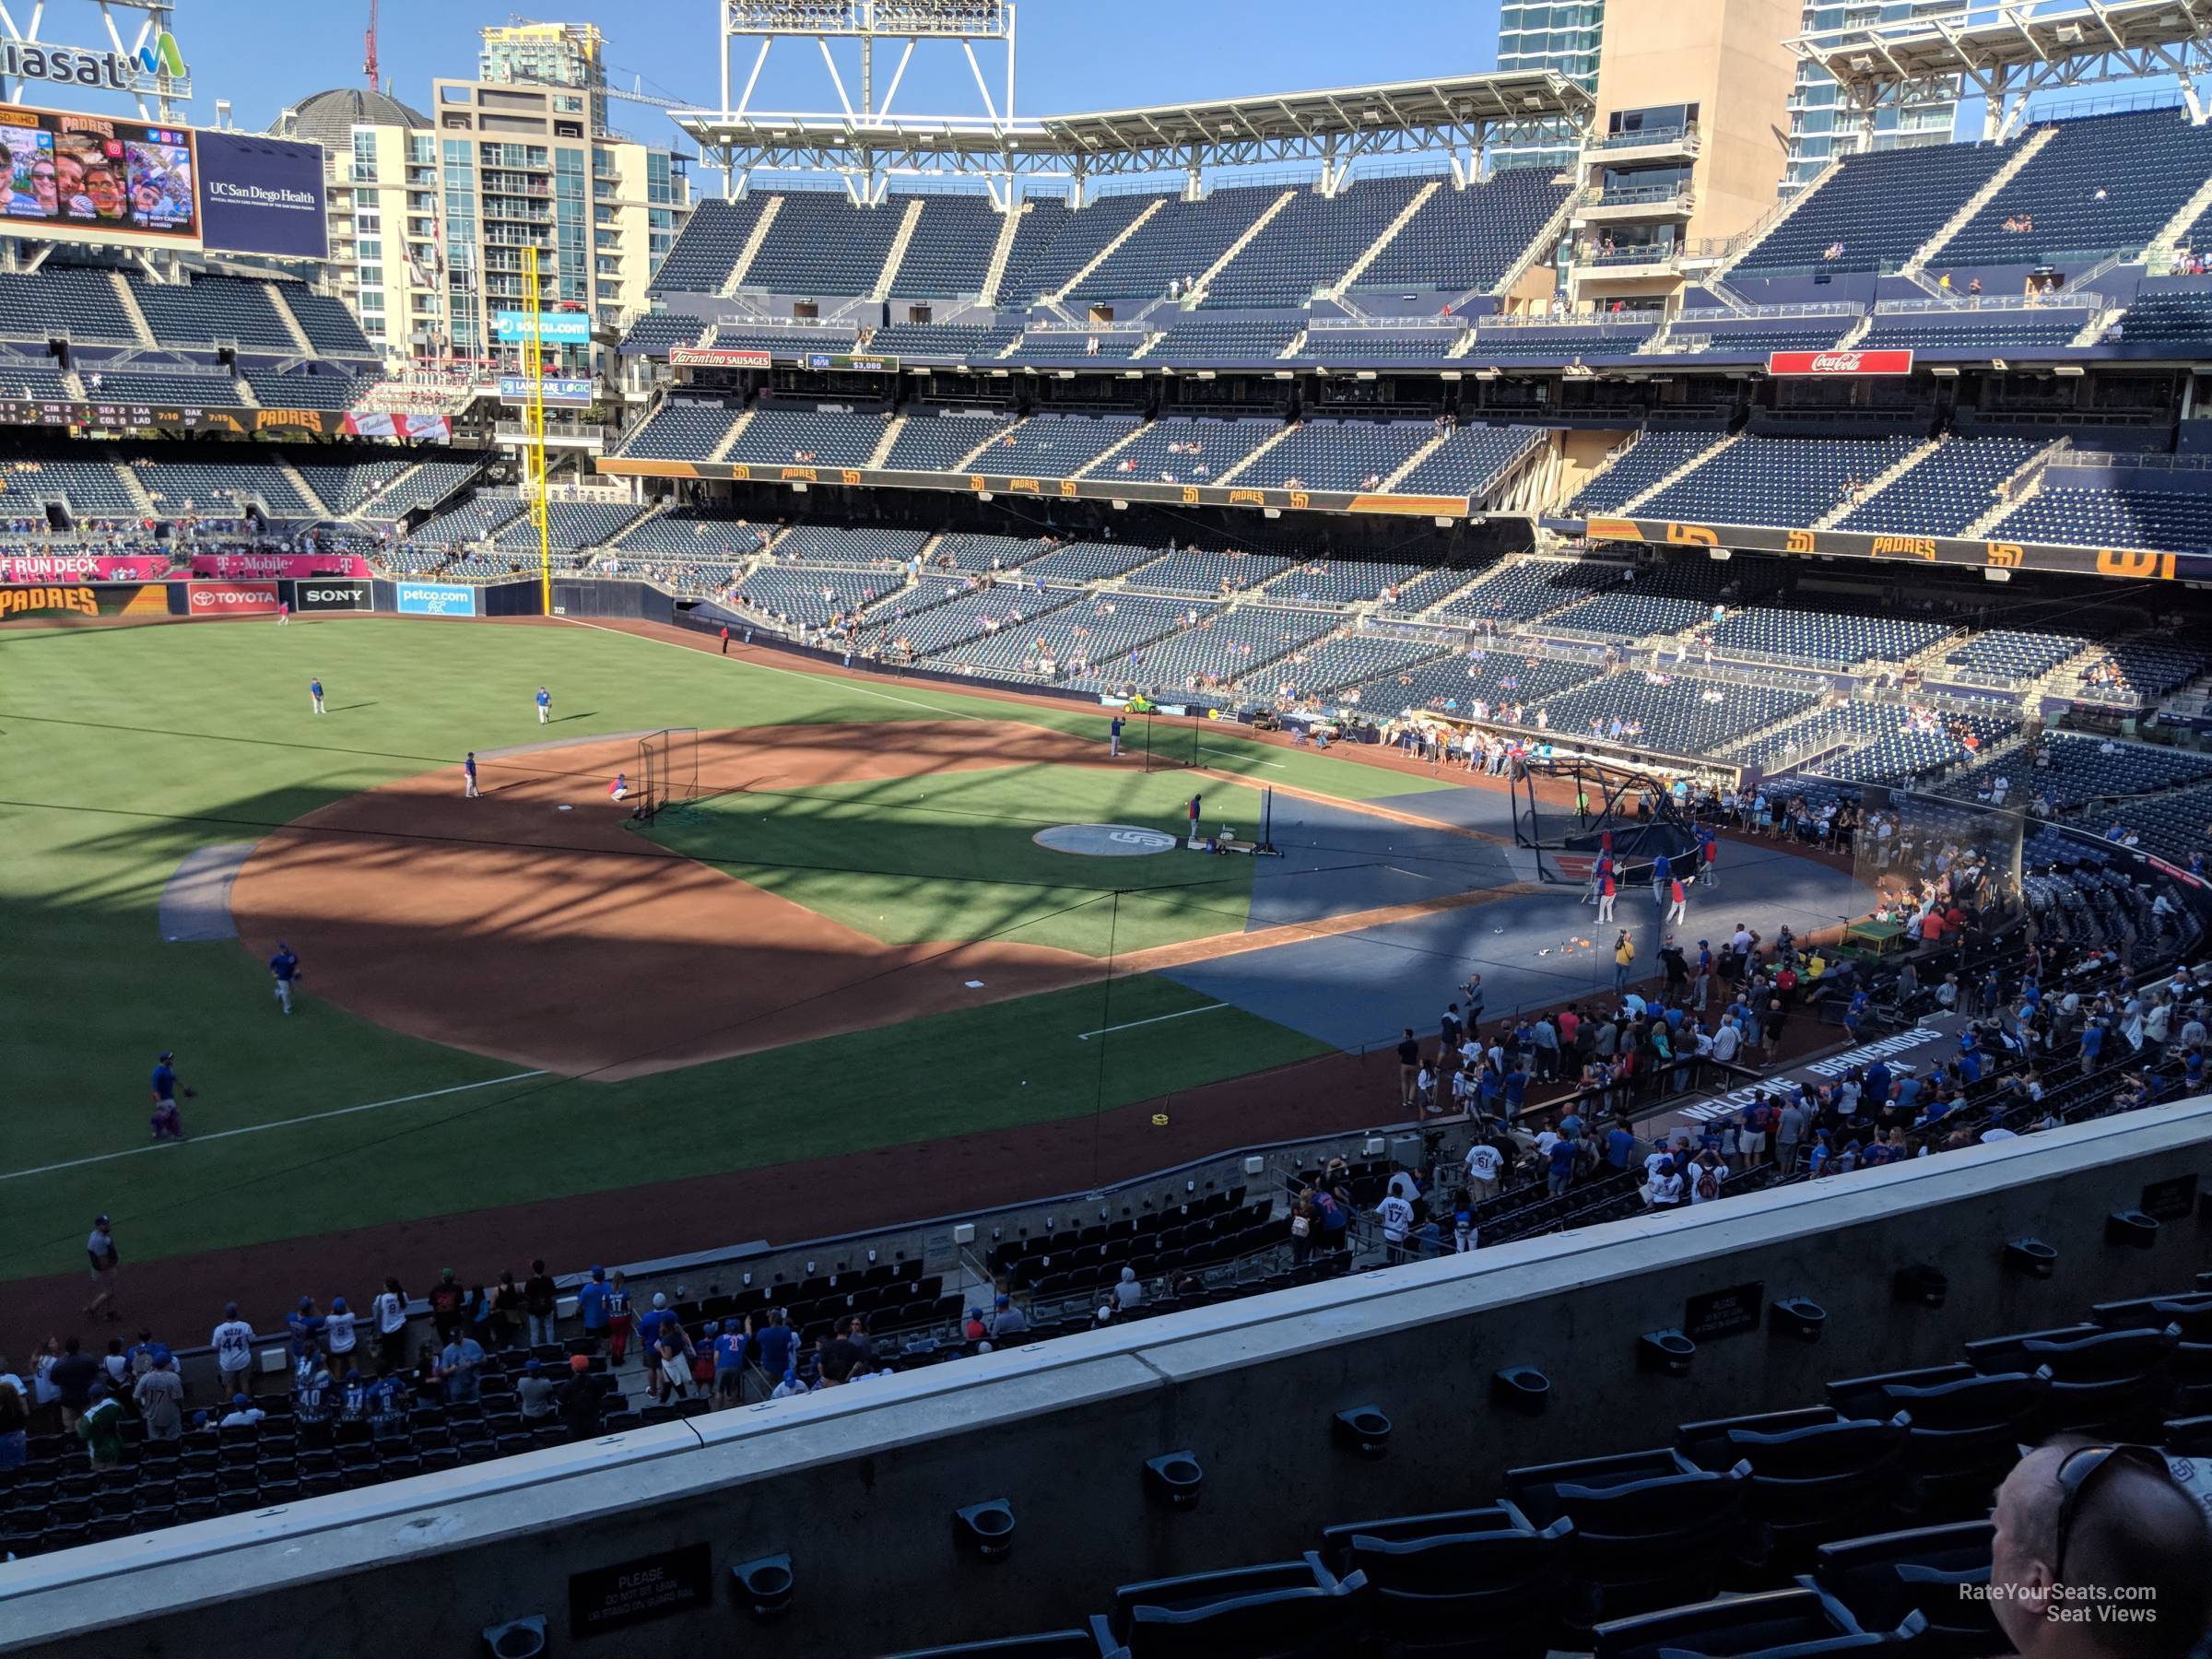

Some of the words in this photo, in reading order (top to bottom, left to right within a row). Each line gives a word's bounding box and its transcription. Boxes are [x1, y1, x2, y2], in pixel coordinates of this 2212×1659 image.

[61, 116, 114, 138] PADRES
[210, 182, 228, 195] UC
[228, 184, 249, 197] San
[250, 186, 280, 202] Diego
[280, 189, 315, 204] Health
[673, 350, 725, 364] Tarantino
[726, 356, 769, 366] SAUSAGES
[99, 406, 116, 415] SEA
[185, 408, 203, 417] OAK
[257, 410, 324, 432] PADRES
[782, 467, 818, 482] PADRES
[1010, 479, 1040, 493] PADRES
[1230, 489, 1265, 505] PADRES
[1872, 536, 1935, 561] PADRES
[16, 559, 53, 573] RUN
[54, 559, 100, 572] DECK
[0, 587, 100, 618] PADRES
[217, 592, 275, 605] TOYOTA
[306, 590, 364, 602] SONY
[403, 589, 468, 603] petco.com
[554, 606, 566, 615] 322
[1805, 1027, 1944, 1077] BIENVENIDOS
[1677, 1076, 1803, 1123] WELCOME
[1477, 1157, 1488, 1169] 51
[1389, 1209, 1403, 1224] 17
[610, 1298, 623, 1312] 17
[222, 1336, 242, 1352] 44
[150, 1390, 164, 1404] 17
[300, 1390, 321, 1407] 40
[618, 1567, 665, 1589] PLEASE
[603, 1604, 631, 1618] STAND
[632, 1600, 645, 1611] ON
[647, 1594, 676, 1607] GUARD
[605, 1594, 618, 1606] DO
[620, 1590, 637, 1602] NOT
